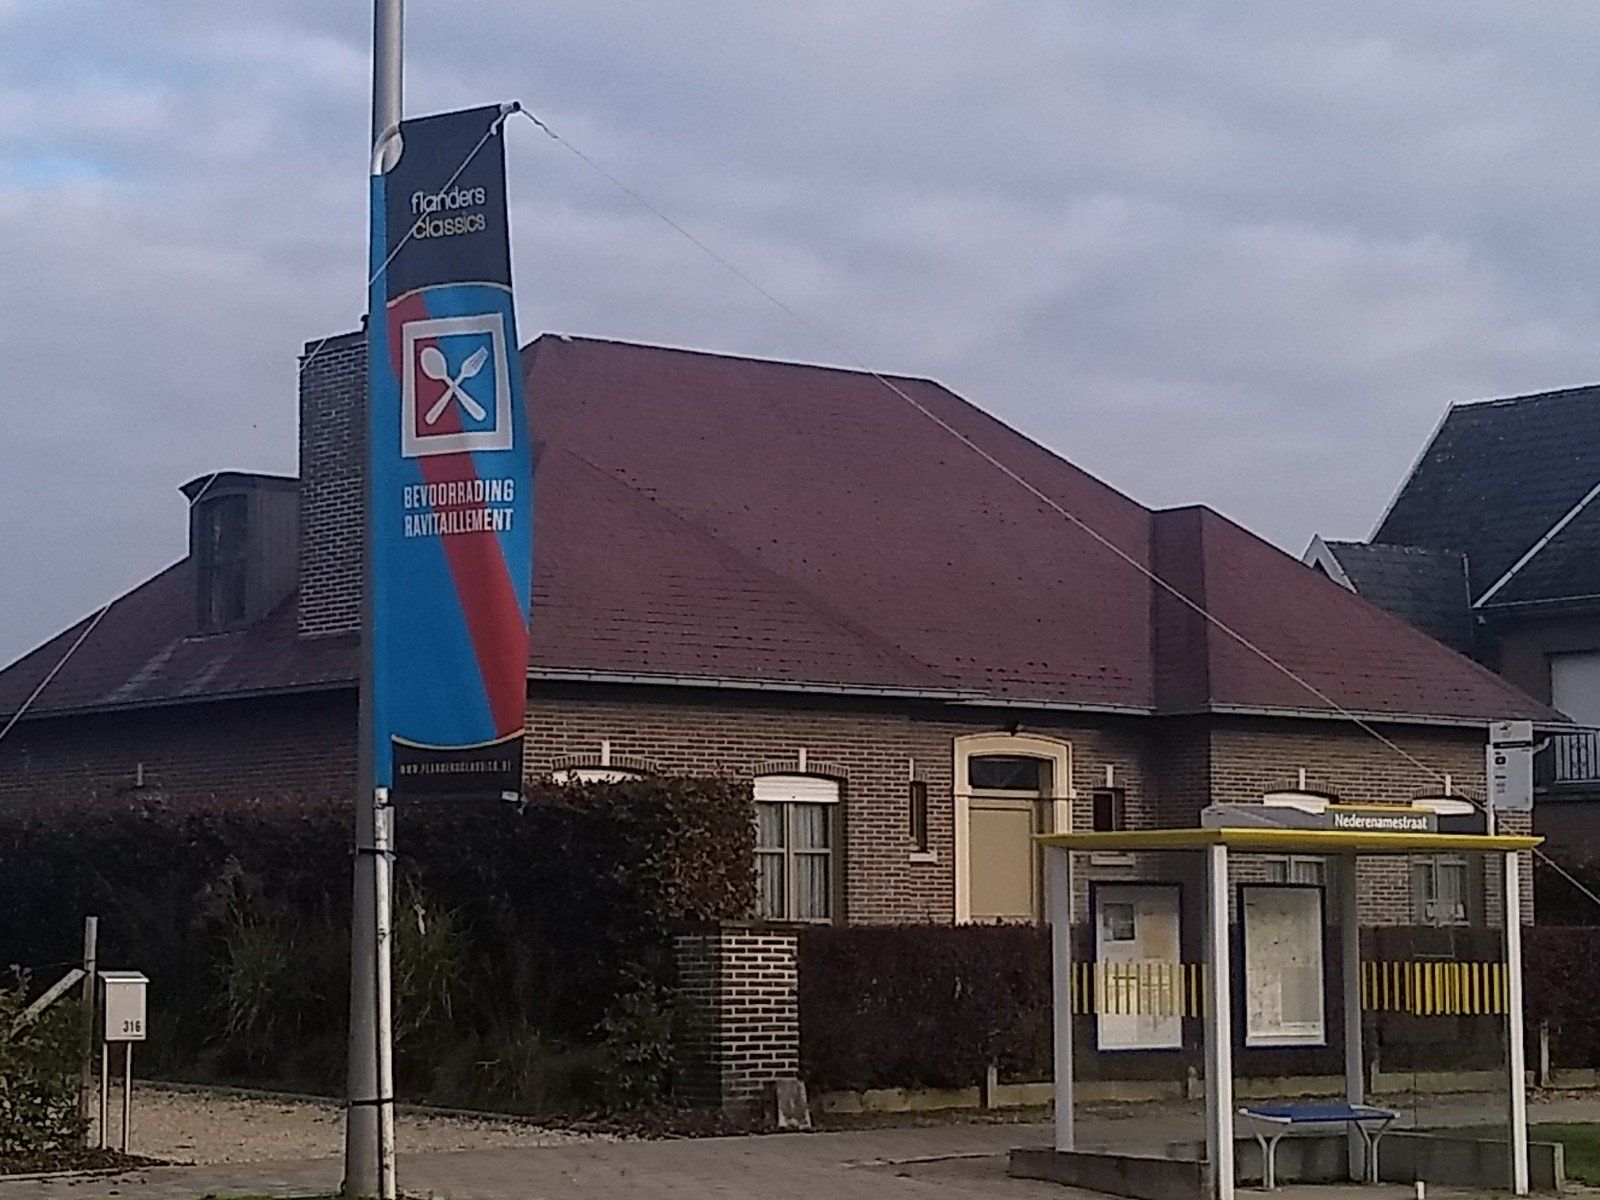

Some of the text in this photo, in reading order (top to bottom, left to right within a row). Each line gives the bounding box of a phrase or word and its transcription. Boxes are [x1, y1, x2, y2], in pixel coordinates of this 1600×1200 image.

[411, 186, 485, 214] flanders
[413, 211, 486, 239] classics
[404, 479, 515, 509] BEVOORRADING
[404, 508, 514, 537] RAVITAILLEMENT
[1334, 813, 1428, 830] Nederenamestraat
[123, 1020, 141, 1033] 316
